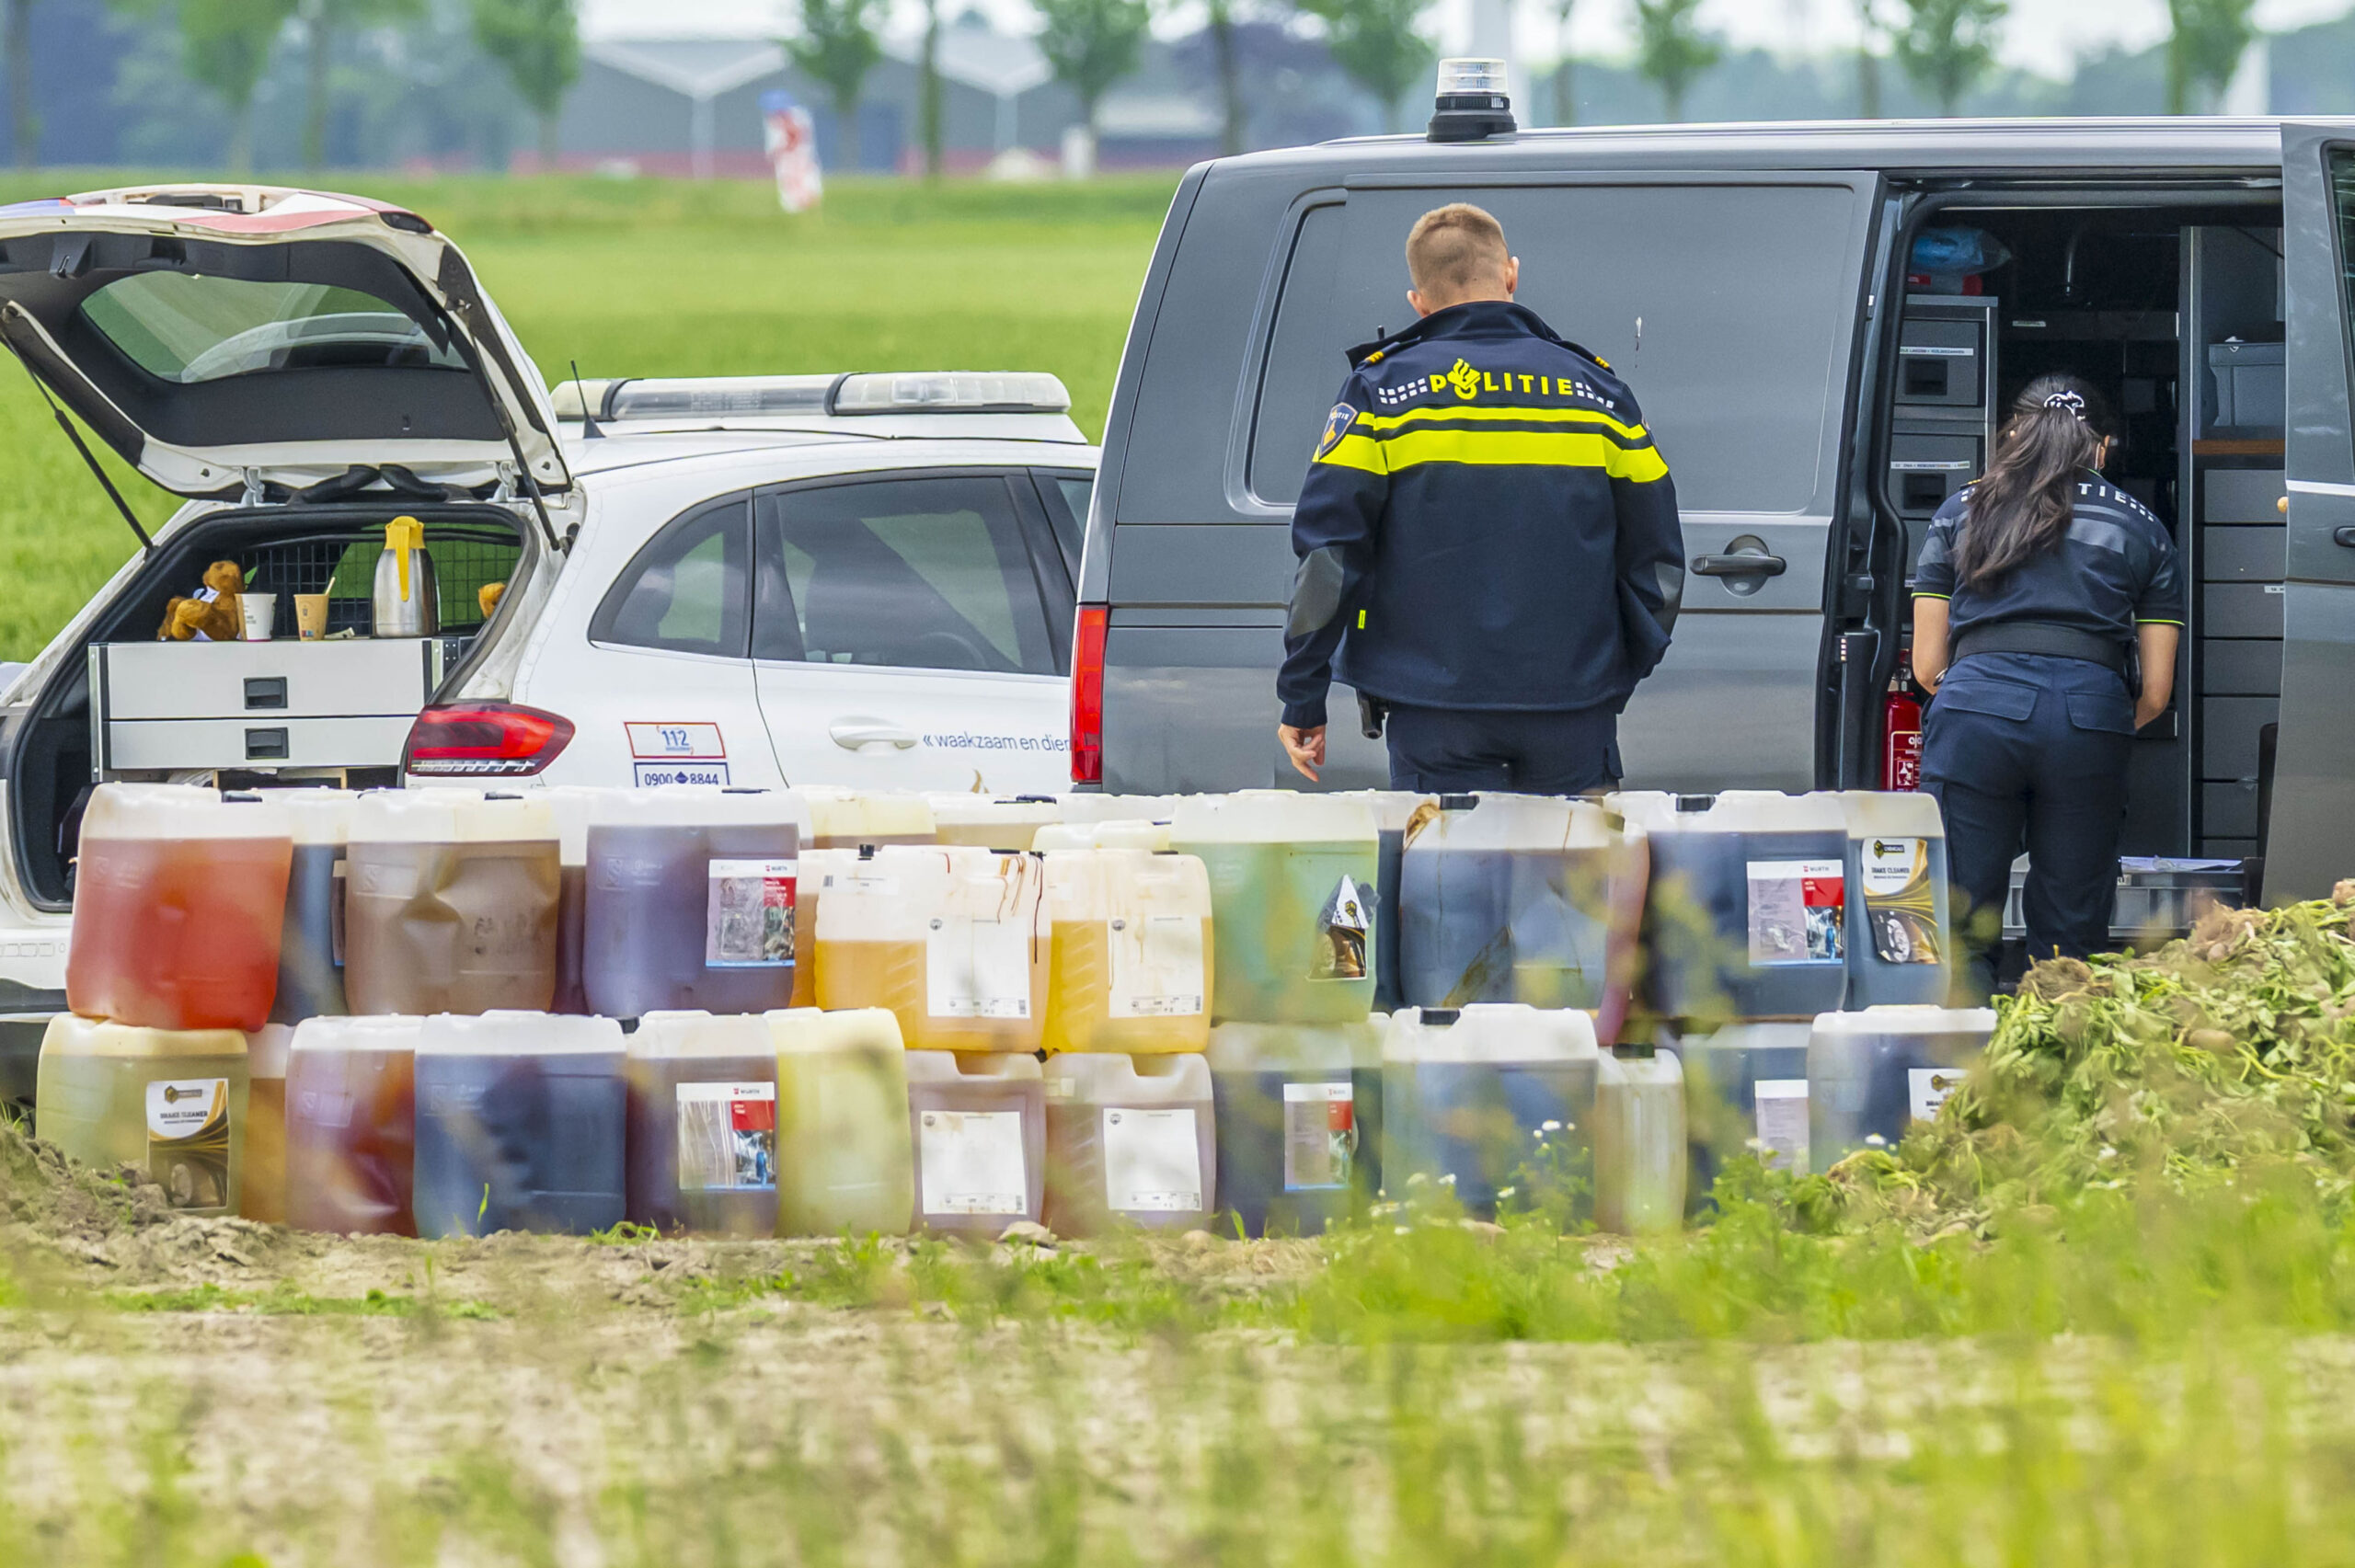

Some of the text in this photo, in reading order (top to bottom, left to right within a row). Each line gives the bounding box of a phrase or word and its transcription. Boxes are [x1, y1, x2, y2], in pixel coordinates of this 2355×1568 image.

[1430, 370, 1573, 399] POLITIE
[661, 729, 690, 746] 112
[935, 732, 1017, 750] waakzaam
[1020, 738, 1040, 750] en
[644, 773, 718, 785] 0900 8844
